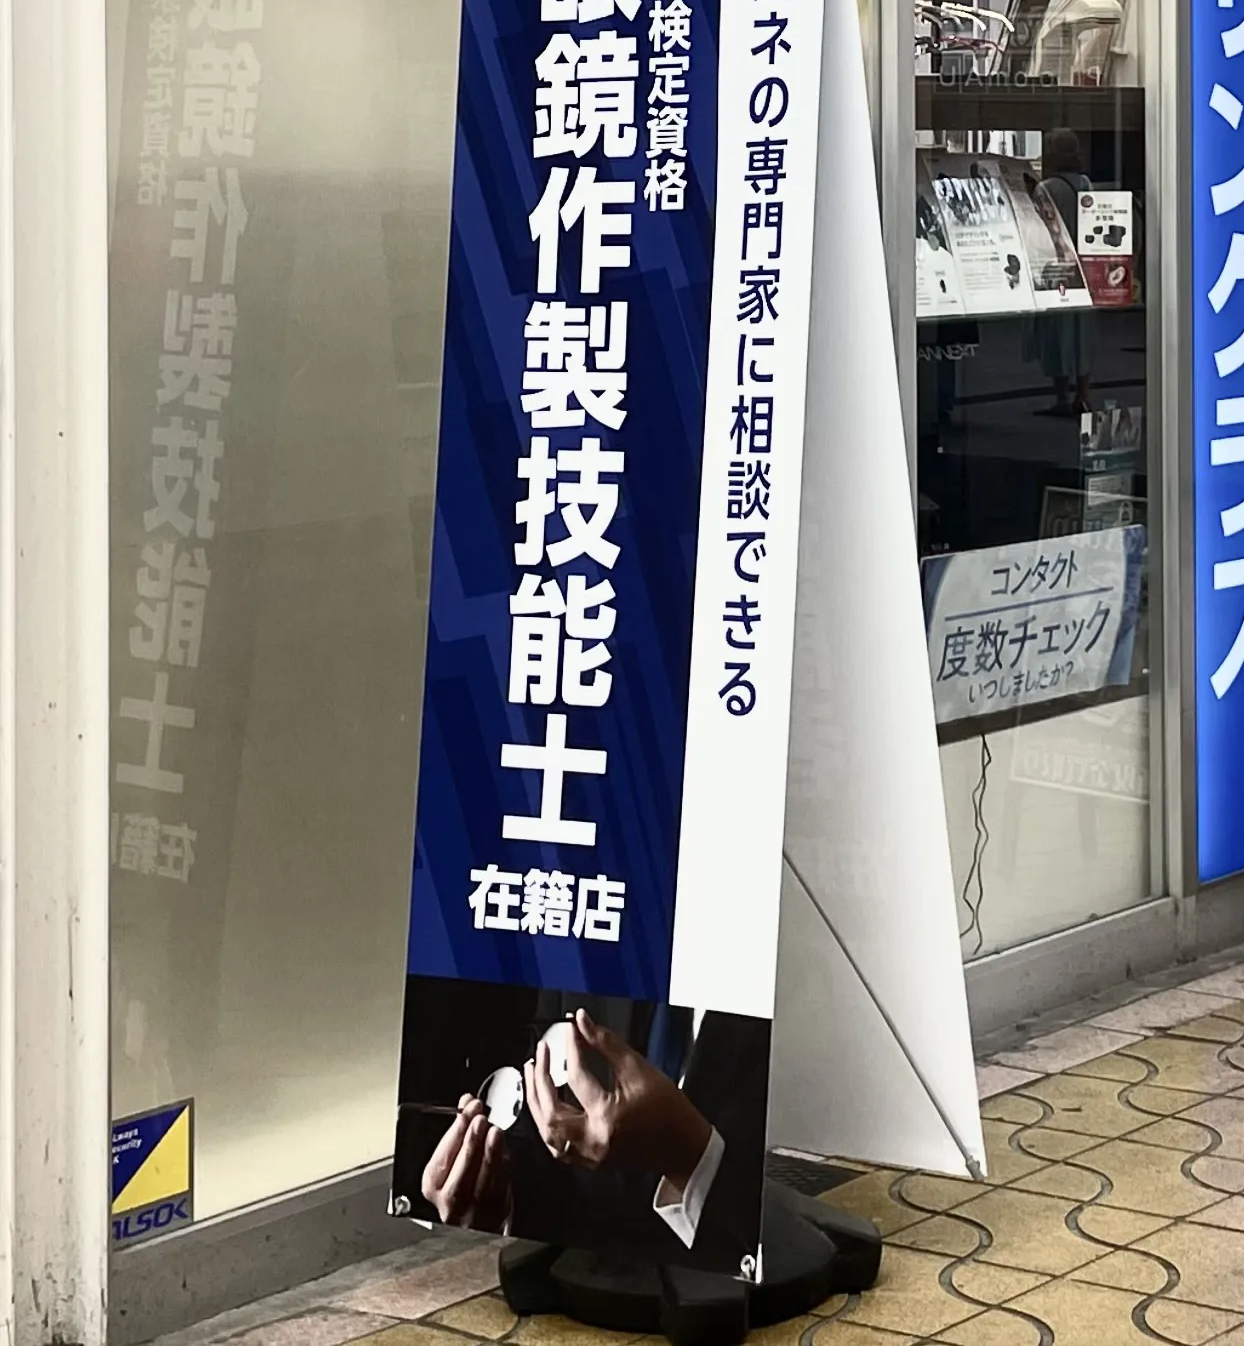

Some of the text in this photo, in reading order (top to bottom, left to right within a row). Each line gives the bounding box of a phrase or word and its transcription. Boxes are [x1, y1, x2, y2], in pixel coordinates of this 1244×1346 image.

[990, 548, 1080, 597] コンタクト
[936, 599, 1112, 684] 度数チェック
[468, 864, 626, 943] 在籍店
[112, 1127, 139, 1143] lways
[112, 1138, 143, 1154] ecurity
